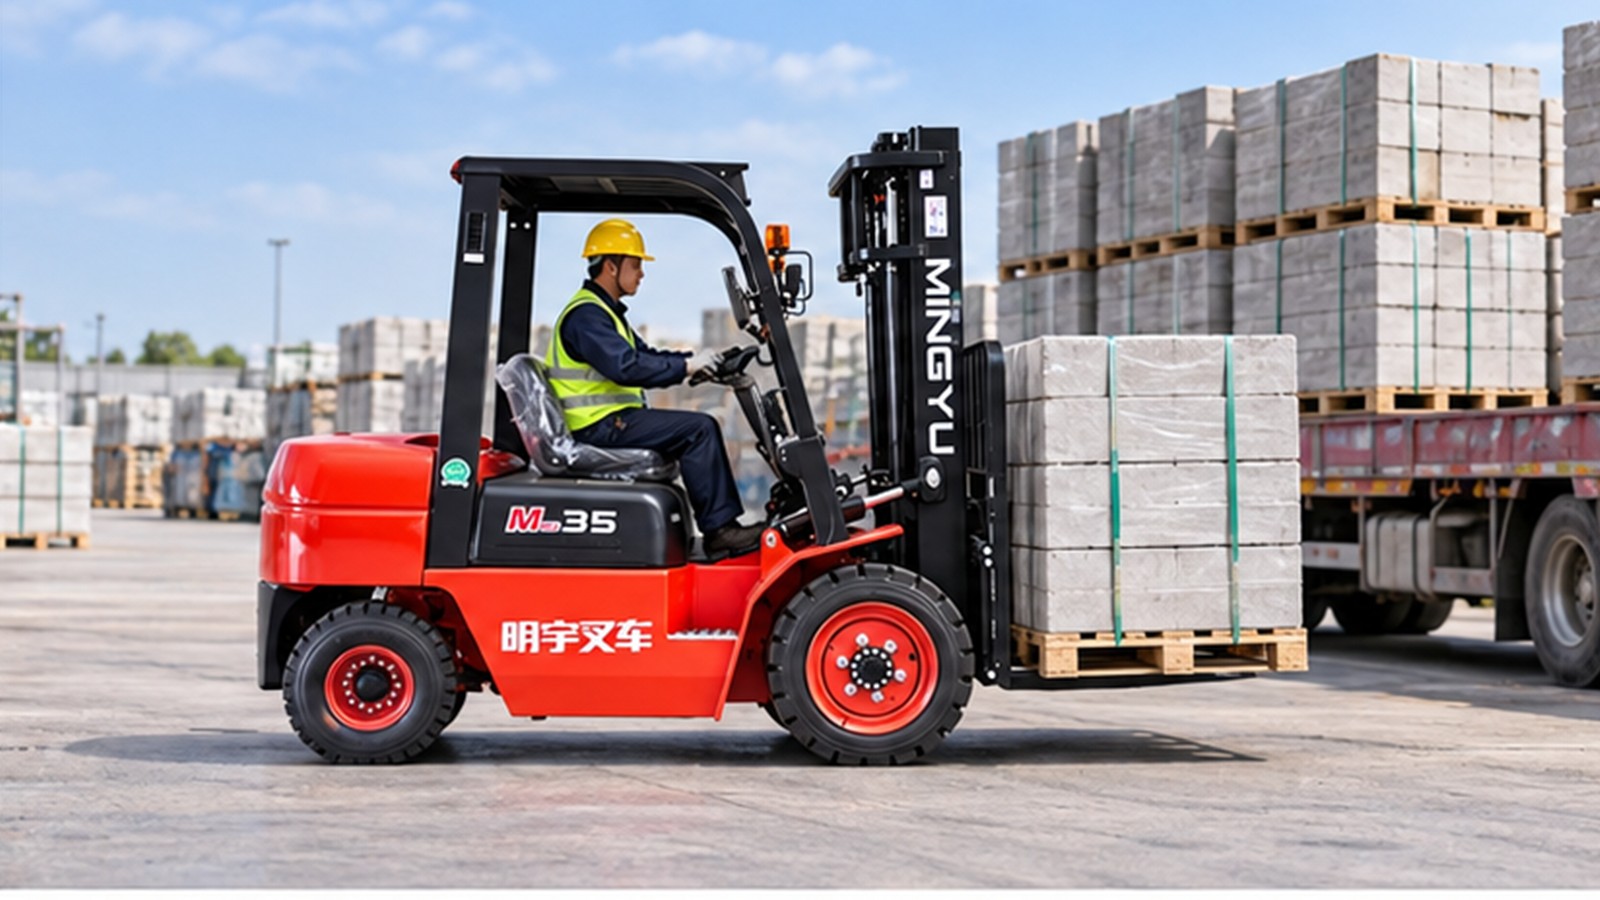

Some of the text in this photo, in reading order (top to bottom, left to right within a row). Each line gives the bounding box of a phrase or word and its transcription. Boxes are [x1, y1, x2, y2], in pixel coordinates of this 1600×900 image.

[925, 258, 955, 454] MINGYU
[501, 619, 653, 653] 明宇叉车
